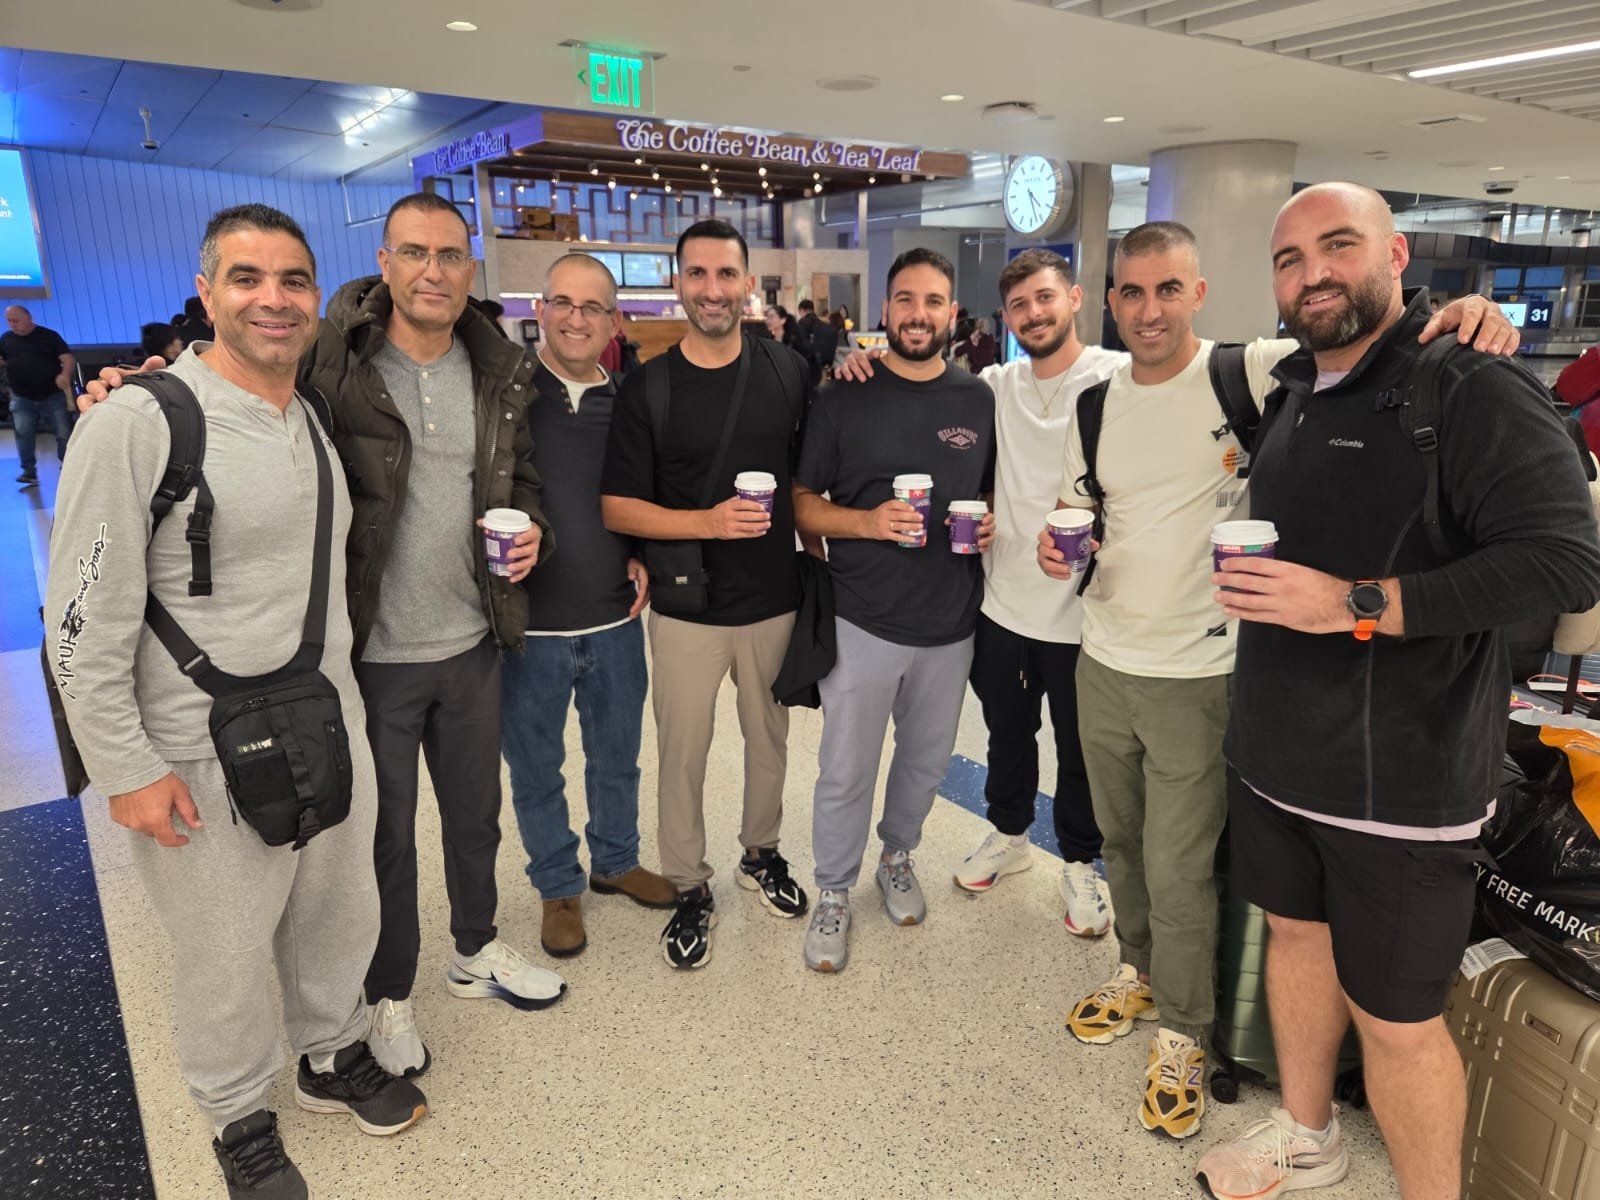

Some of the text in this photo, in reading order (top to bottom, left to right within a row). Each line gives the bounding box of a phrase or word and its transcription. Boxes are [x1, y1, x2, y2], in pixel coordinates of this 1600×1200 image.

[589, 53, 643, 107] EXIT
[616, 120, 924, 172] The Coffee Bean & Tea Leaf
[1531, 308, 1549, 322] 31
[58, 524, 106, 700] MAUI and Sons
[1486, 873, 1534, 910] FREE
